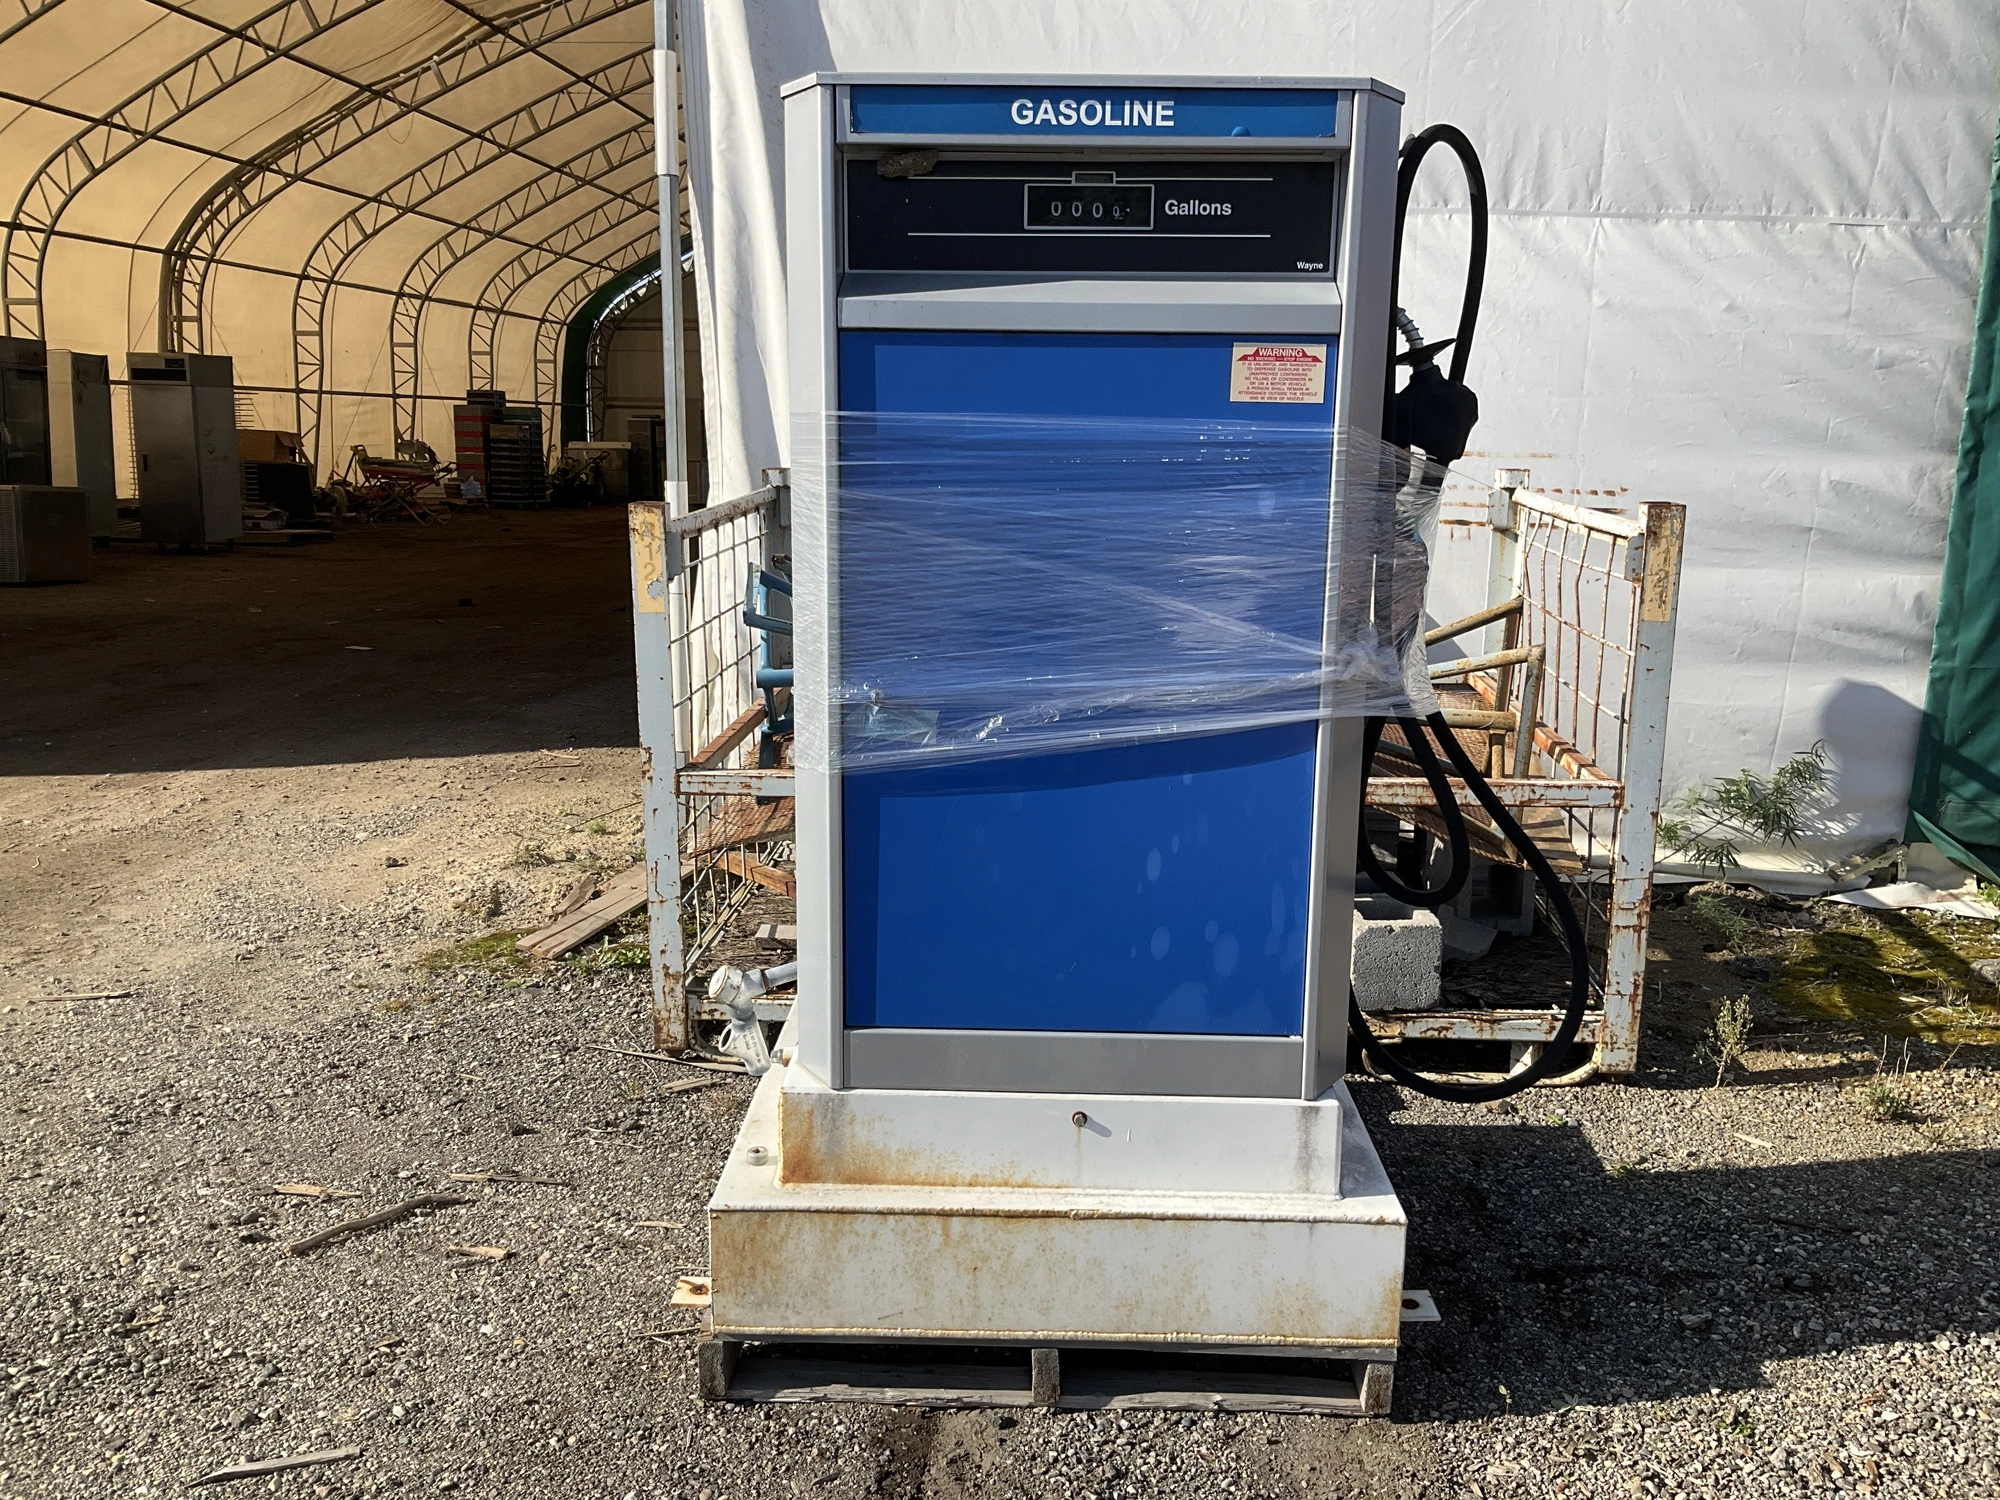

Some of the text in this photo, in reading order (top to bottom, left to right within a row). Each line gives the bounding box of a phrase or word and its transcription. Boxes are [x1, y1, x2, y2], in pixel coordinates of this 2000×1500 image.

[1011, 98, 1174, 126] GASOLINE
[1165, 199, 1232, 216] Gallons
[1297, 261, 1324, 271] Wayne
[1259, 348, 1302, 357] WARNING
